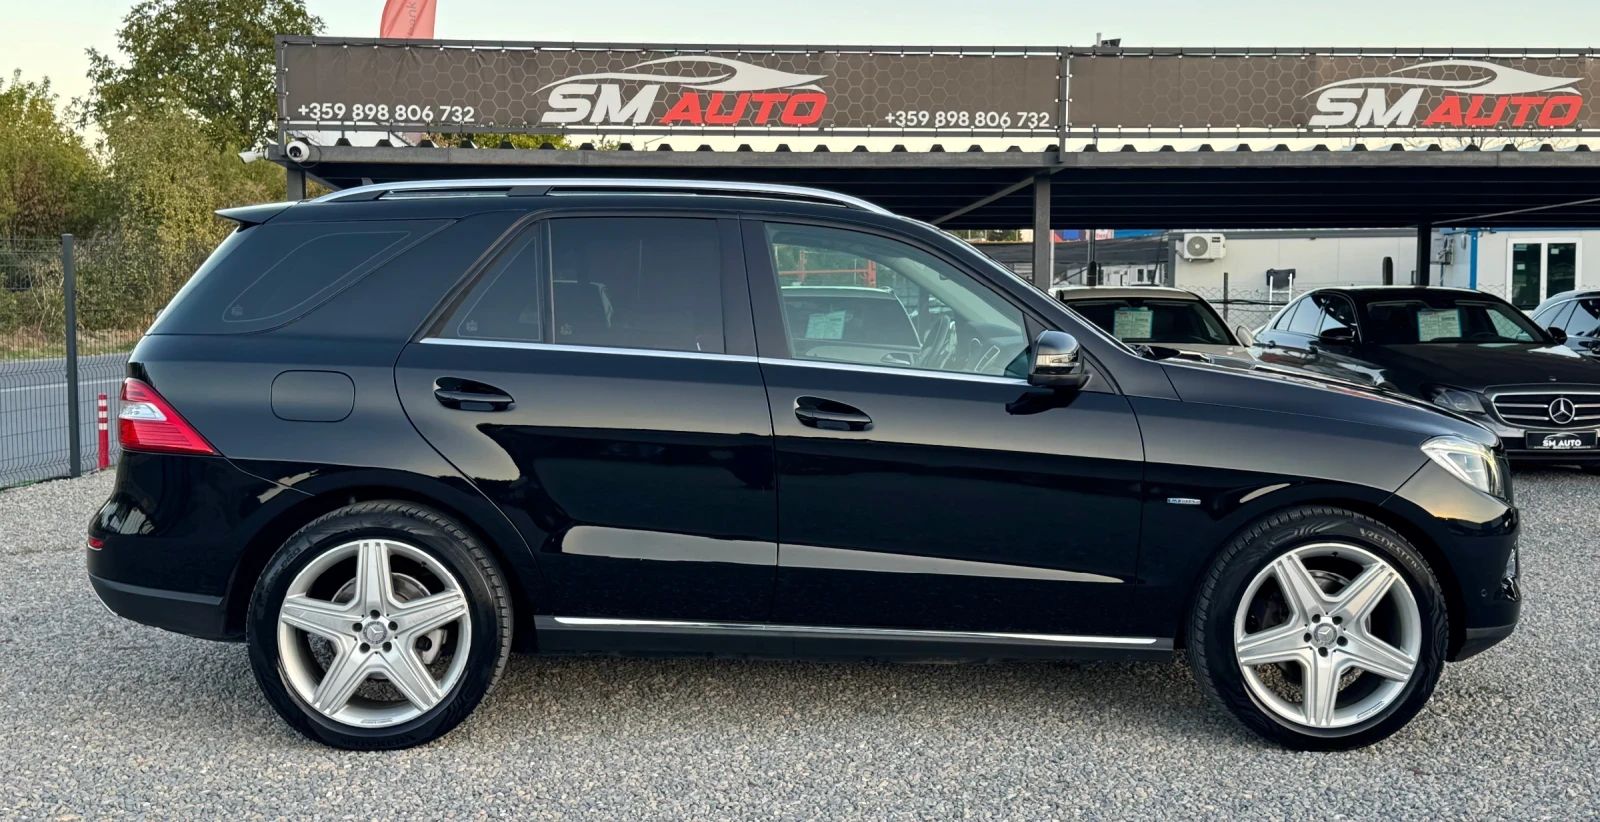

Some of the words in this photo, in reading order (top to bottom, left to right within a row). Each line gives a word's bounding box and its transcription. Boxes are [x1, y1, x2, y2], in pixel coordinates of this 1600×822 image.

[298, 103, 345, 119] +359
[352, 103, 389, 121] 898
[395, 104, 433, 122] 806
[440, 105, 475, 122] 732
[541, 83, 661, 124] SM
[659, 92, 828, 125] AUTO
[1308, 87, 1424, 126] SM
[1421, 95, 1583, 127] AUTO
[885, 110, 929, 126] +359
[935, 111, 969, 127] 898
[974, 111, 1011, 128] 806
[1017, 112, 1050, 128] 732
[1542, 439, 1556, 447] SM
[1557, 439, 1582, 447] AUTO
[1359, 527, 1421, 571] VREDESTEIN
